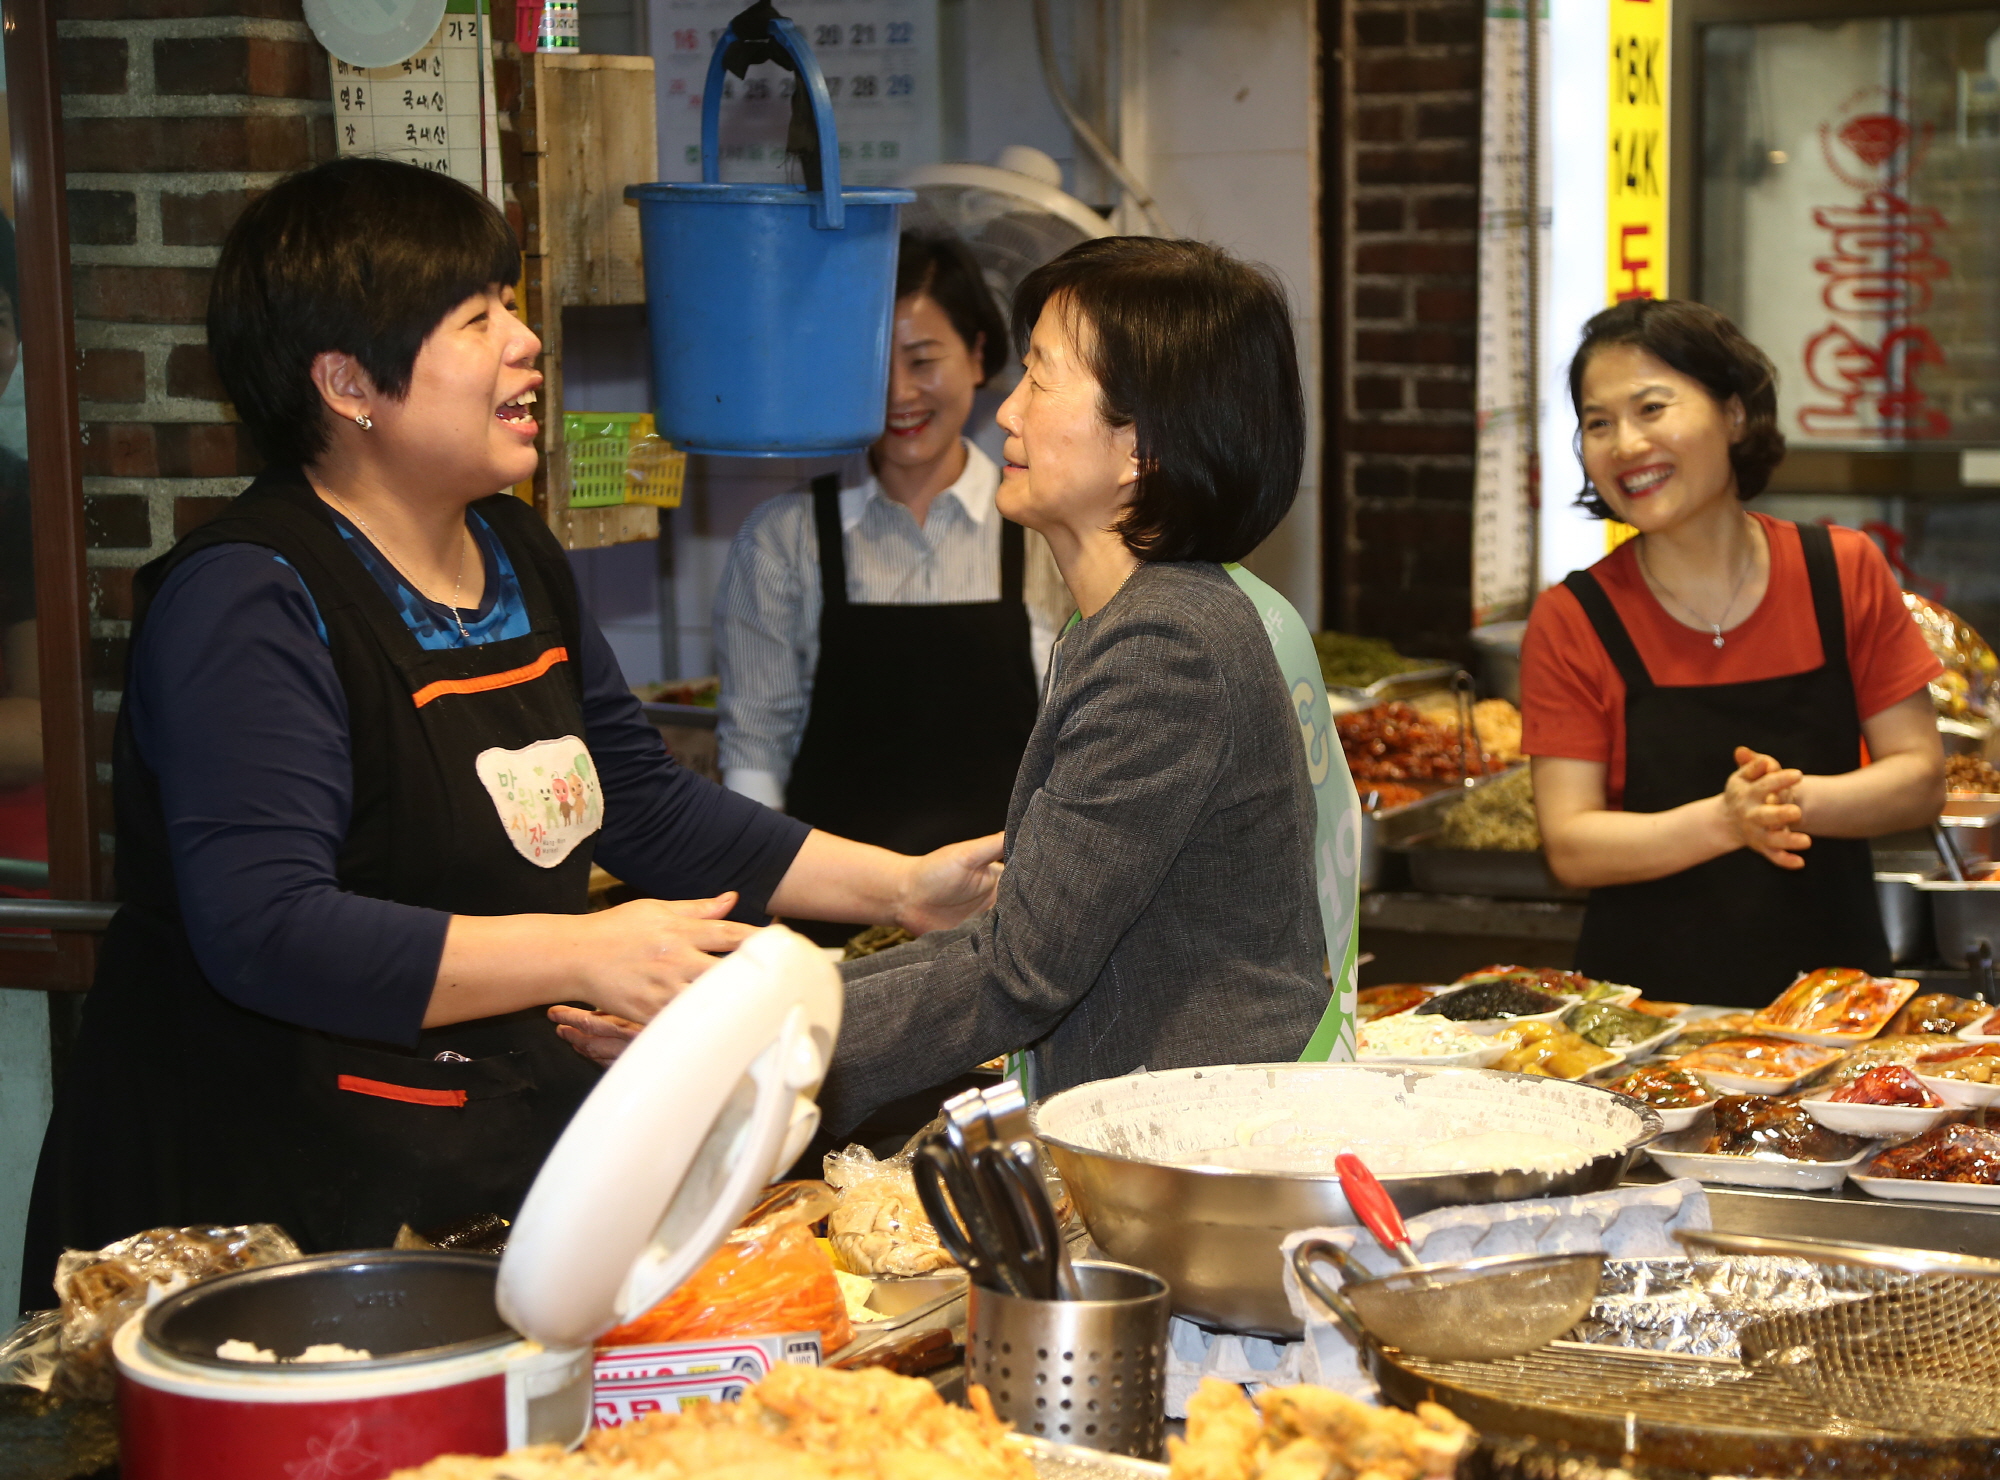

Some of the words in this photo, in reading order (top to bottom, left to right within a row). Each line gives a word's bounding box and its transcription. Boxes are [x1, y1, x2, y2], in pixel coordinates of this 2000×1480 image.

[886, 22, 914, 43] 22
[1613, 37, 1661, 106] 18K
[403, 89, 444, 112] 국내산
[345, 123, 356, 146] 갓
[406, 123, 446, 145] 국내산
[1612, 129, 1659, 197] 14K
